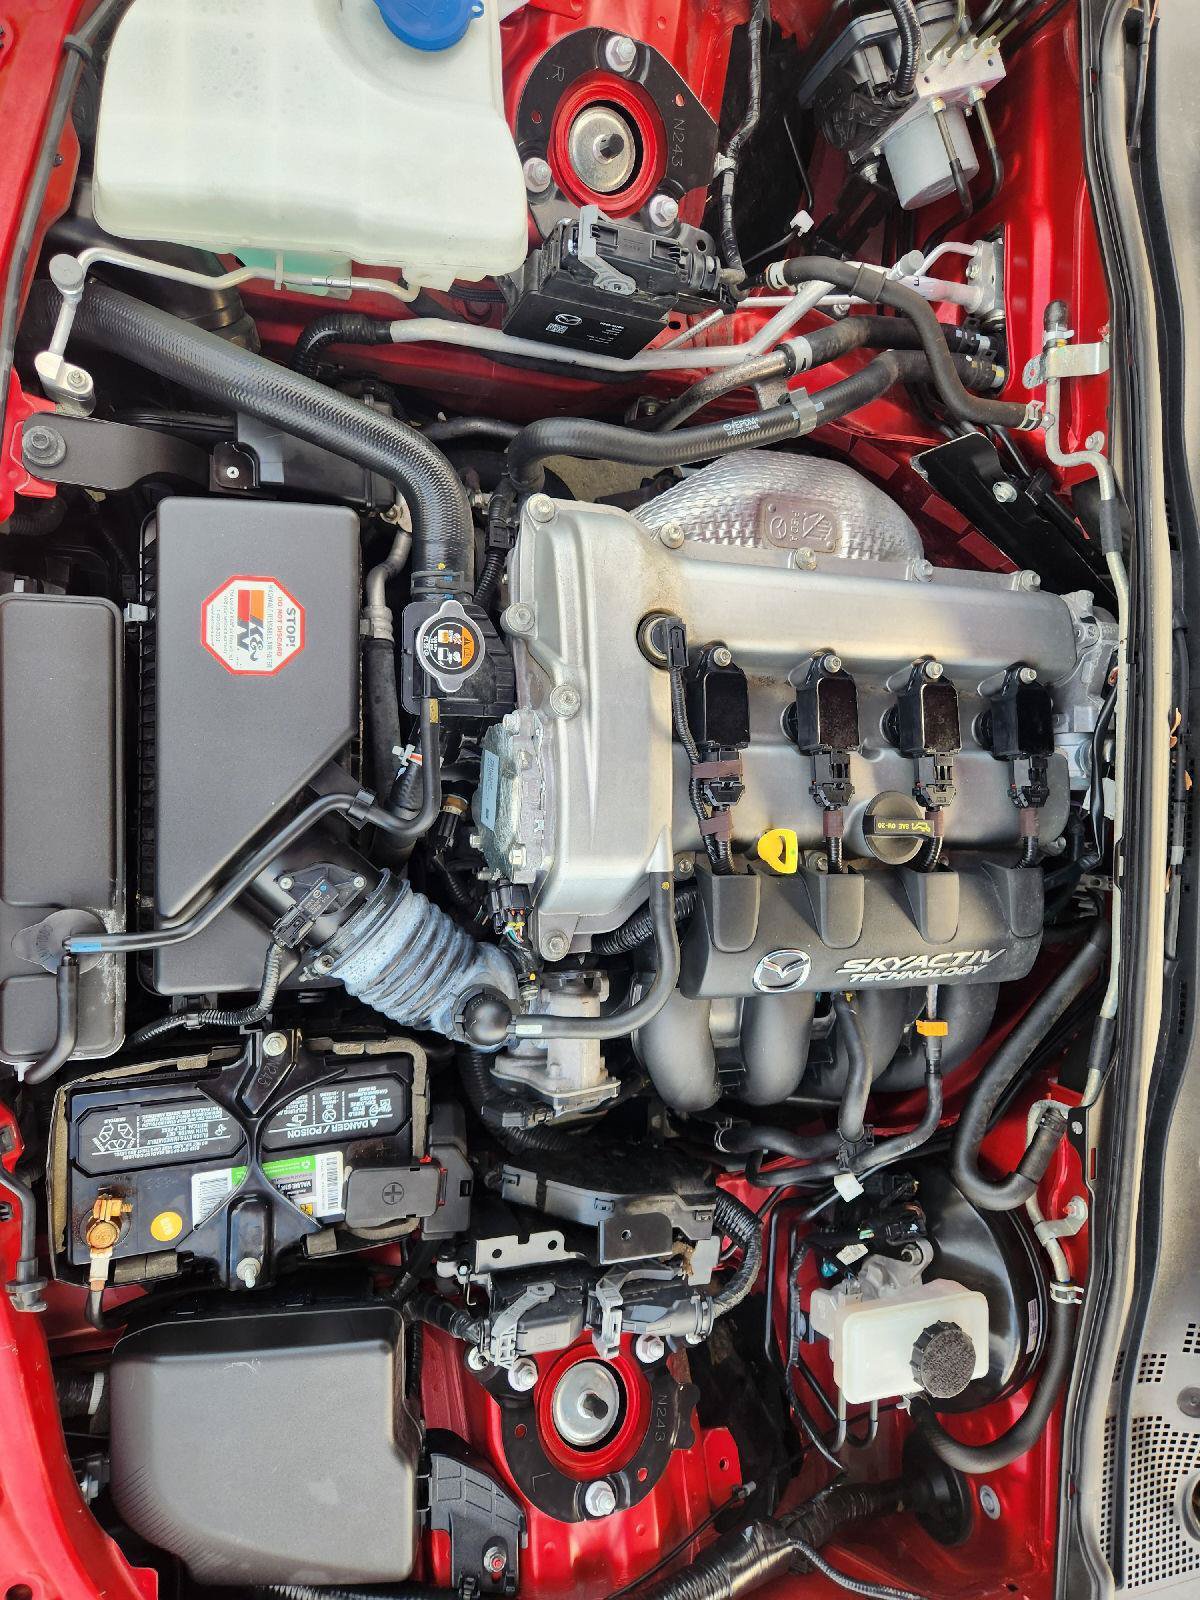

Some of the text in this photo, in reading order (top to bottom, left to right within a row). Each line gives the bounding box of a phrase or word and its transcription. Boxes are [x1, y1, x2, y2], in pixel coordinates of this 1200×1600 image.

[672, 118, 686, 168] N243
[277, 596, 282, 606] DO
[286, 608, 296, 647] STOP!
[835, 948, 1007, 975] SKYACTIV
[850, 964, 988, 983] TECHNOLOGY
[286, 1126, 322, 1138] POISON
[331, 1119, 368, 1132] DANGER
[654, 1392, 668, 1442] N243
